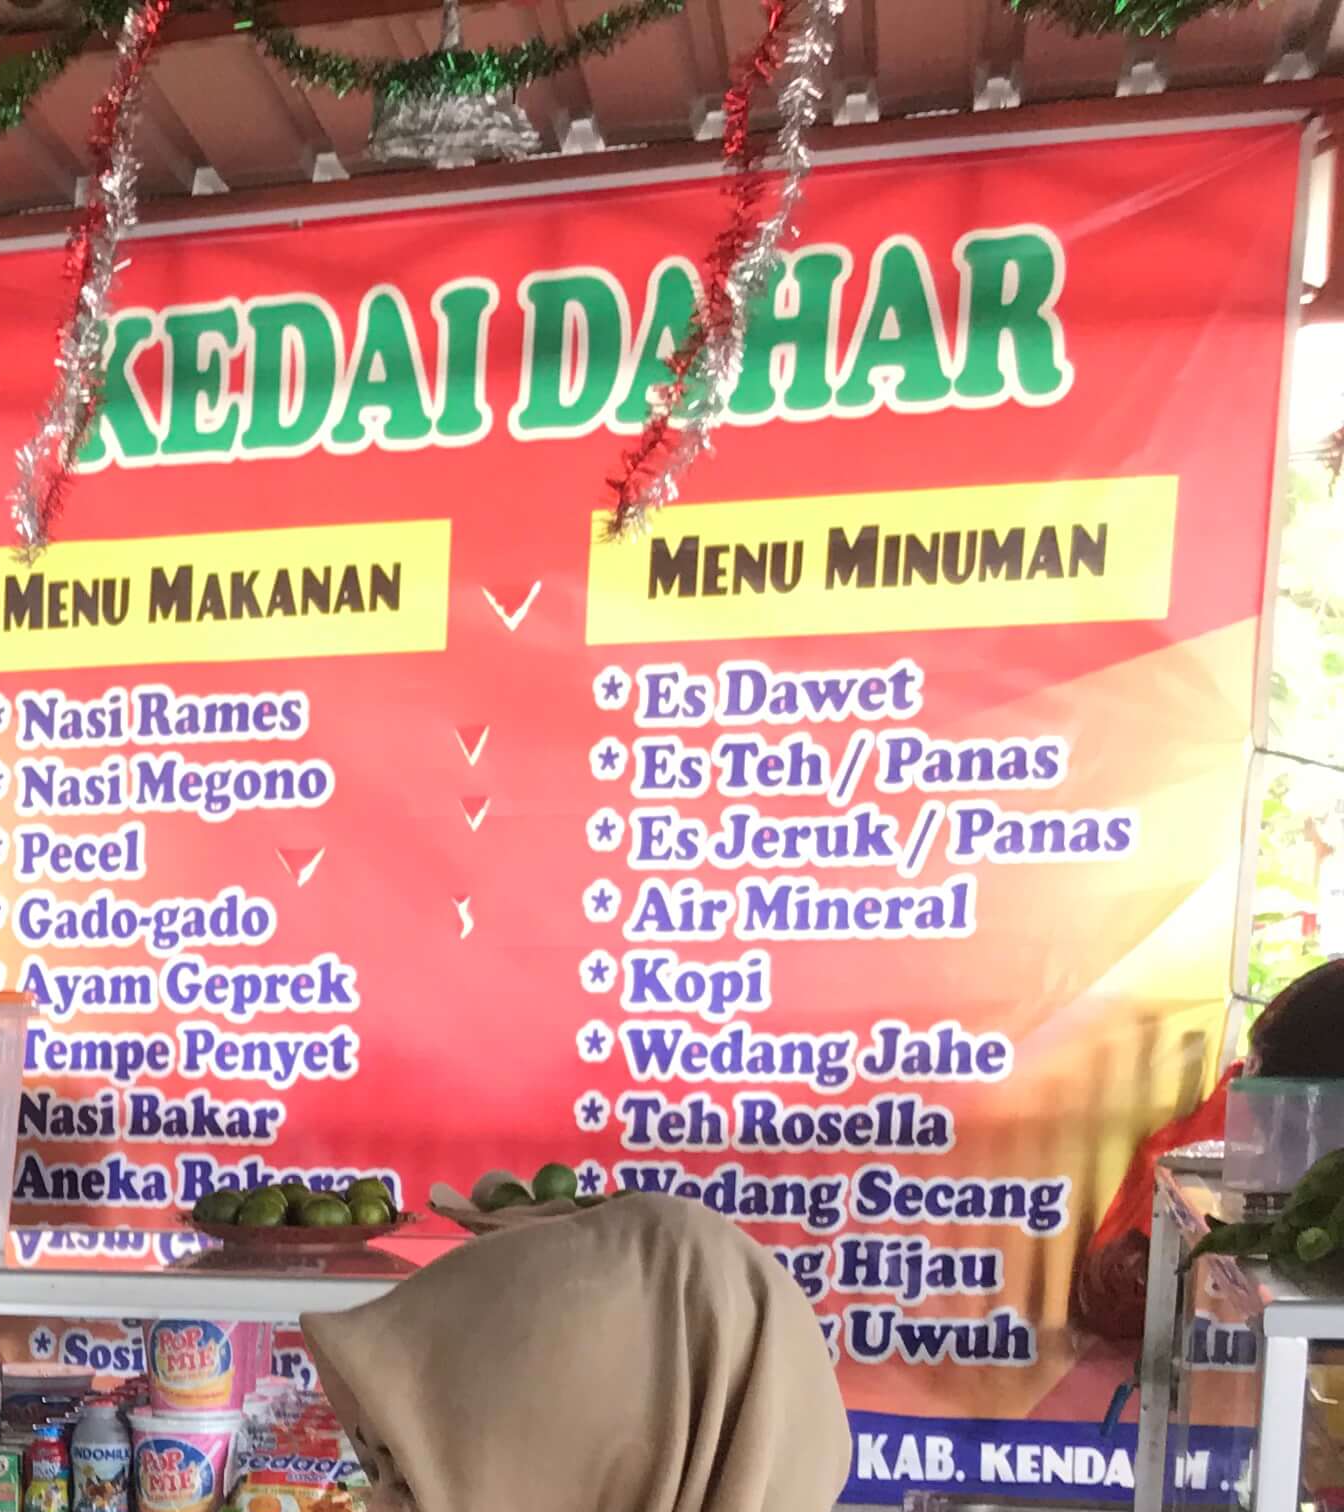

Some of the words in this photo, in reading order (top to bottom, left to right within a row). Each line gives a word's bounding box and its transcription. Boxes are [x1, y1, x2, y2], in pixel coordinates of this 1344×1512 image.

[76, 272, 498, 468] KEDAI
[516, 228, 1072, 437] DAHAR
[23, 695, 123, 741] Nasi
[137, 692, 303, 737] Rames
[643, 672, 706, 718] Es
[723, 666, 916, 716] Dawet
[22, 762, 122, 807] Nasi
[136, 759, 328, 814] Megono
[640, 743, 703, 790] Es
[720, 734, 823, 788] Teh
[884, 735, 1060, 785] Panas
[20, 829, 140, 874] Pecel
[636, 814, 699, 861] Es
[715, 811, 894, 861] Jeruk
[955, 807, 1131, 856] Panas
[18, 894, 270, 948] Gado-gado
[632, 884, 728, 933] Air
[743, 882, 968, 932] Mineral
[22, 962, 152, 1014] Ayam
[166, 960, 352, 1014] Geprek
[629, 957, 764, 1014] Kopi
[23, 1028, 170, 1080] Tempe
[184, 1029, 353, 1082] Penyet
[627, 1028, 851, 1086] Wedang
[864, 1027, 1007, 1076] Jahe
[17, 1093, 116, 1137] Nasi
[128, 1093, 280, 1139] Bakar
[622, 1098, 723, 1145] Teh
[738, 1099, 949, 1147] Rosella
[13, 1156, 167, 1201] Aneka
[855, 1169, 1065, 1231] Secang
[838, 1239, 998, 1299] Hijau
[64, 1332, 144, 1372] Sosi
[850, 1310, 1032, 1364] Uwuh
[857, 1432, 966, 1483] KAB.
[980, 1442, 1136, 1489] KENDA
